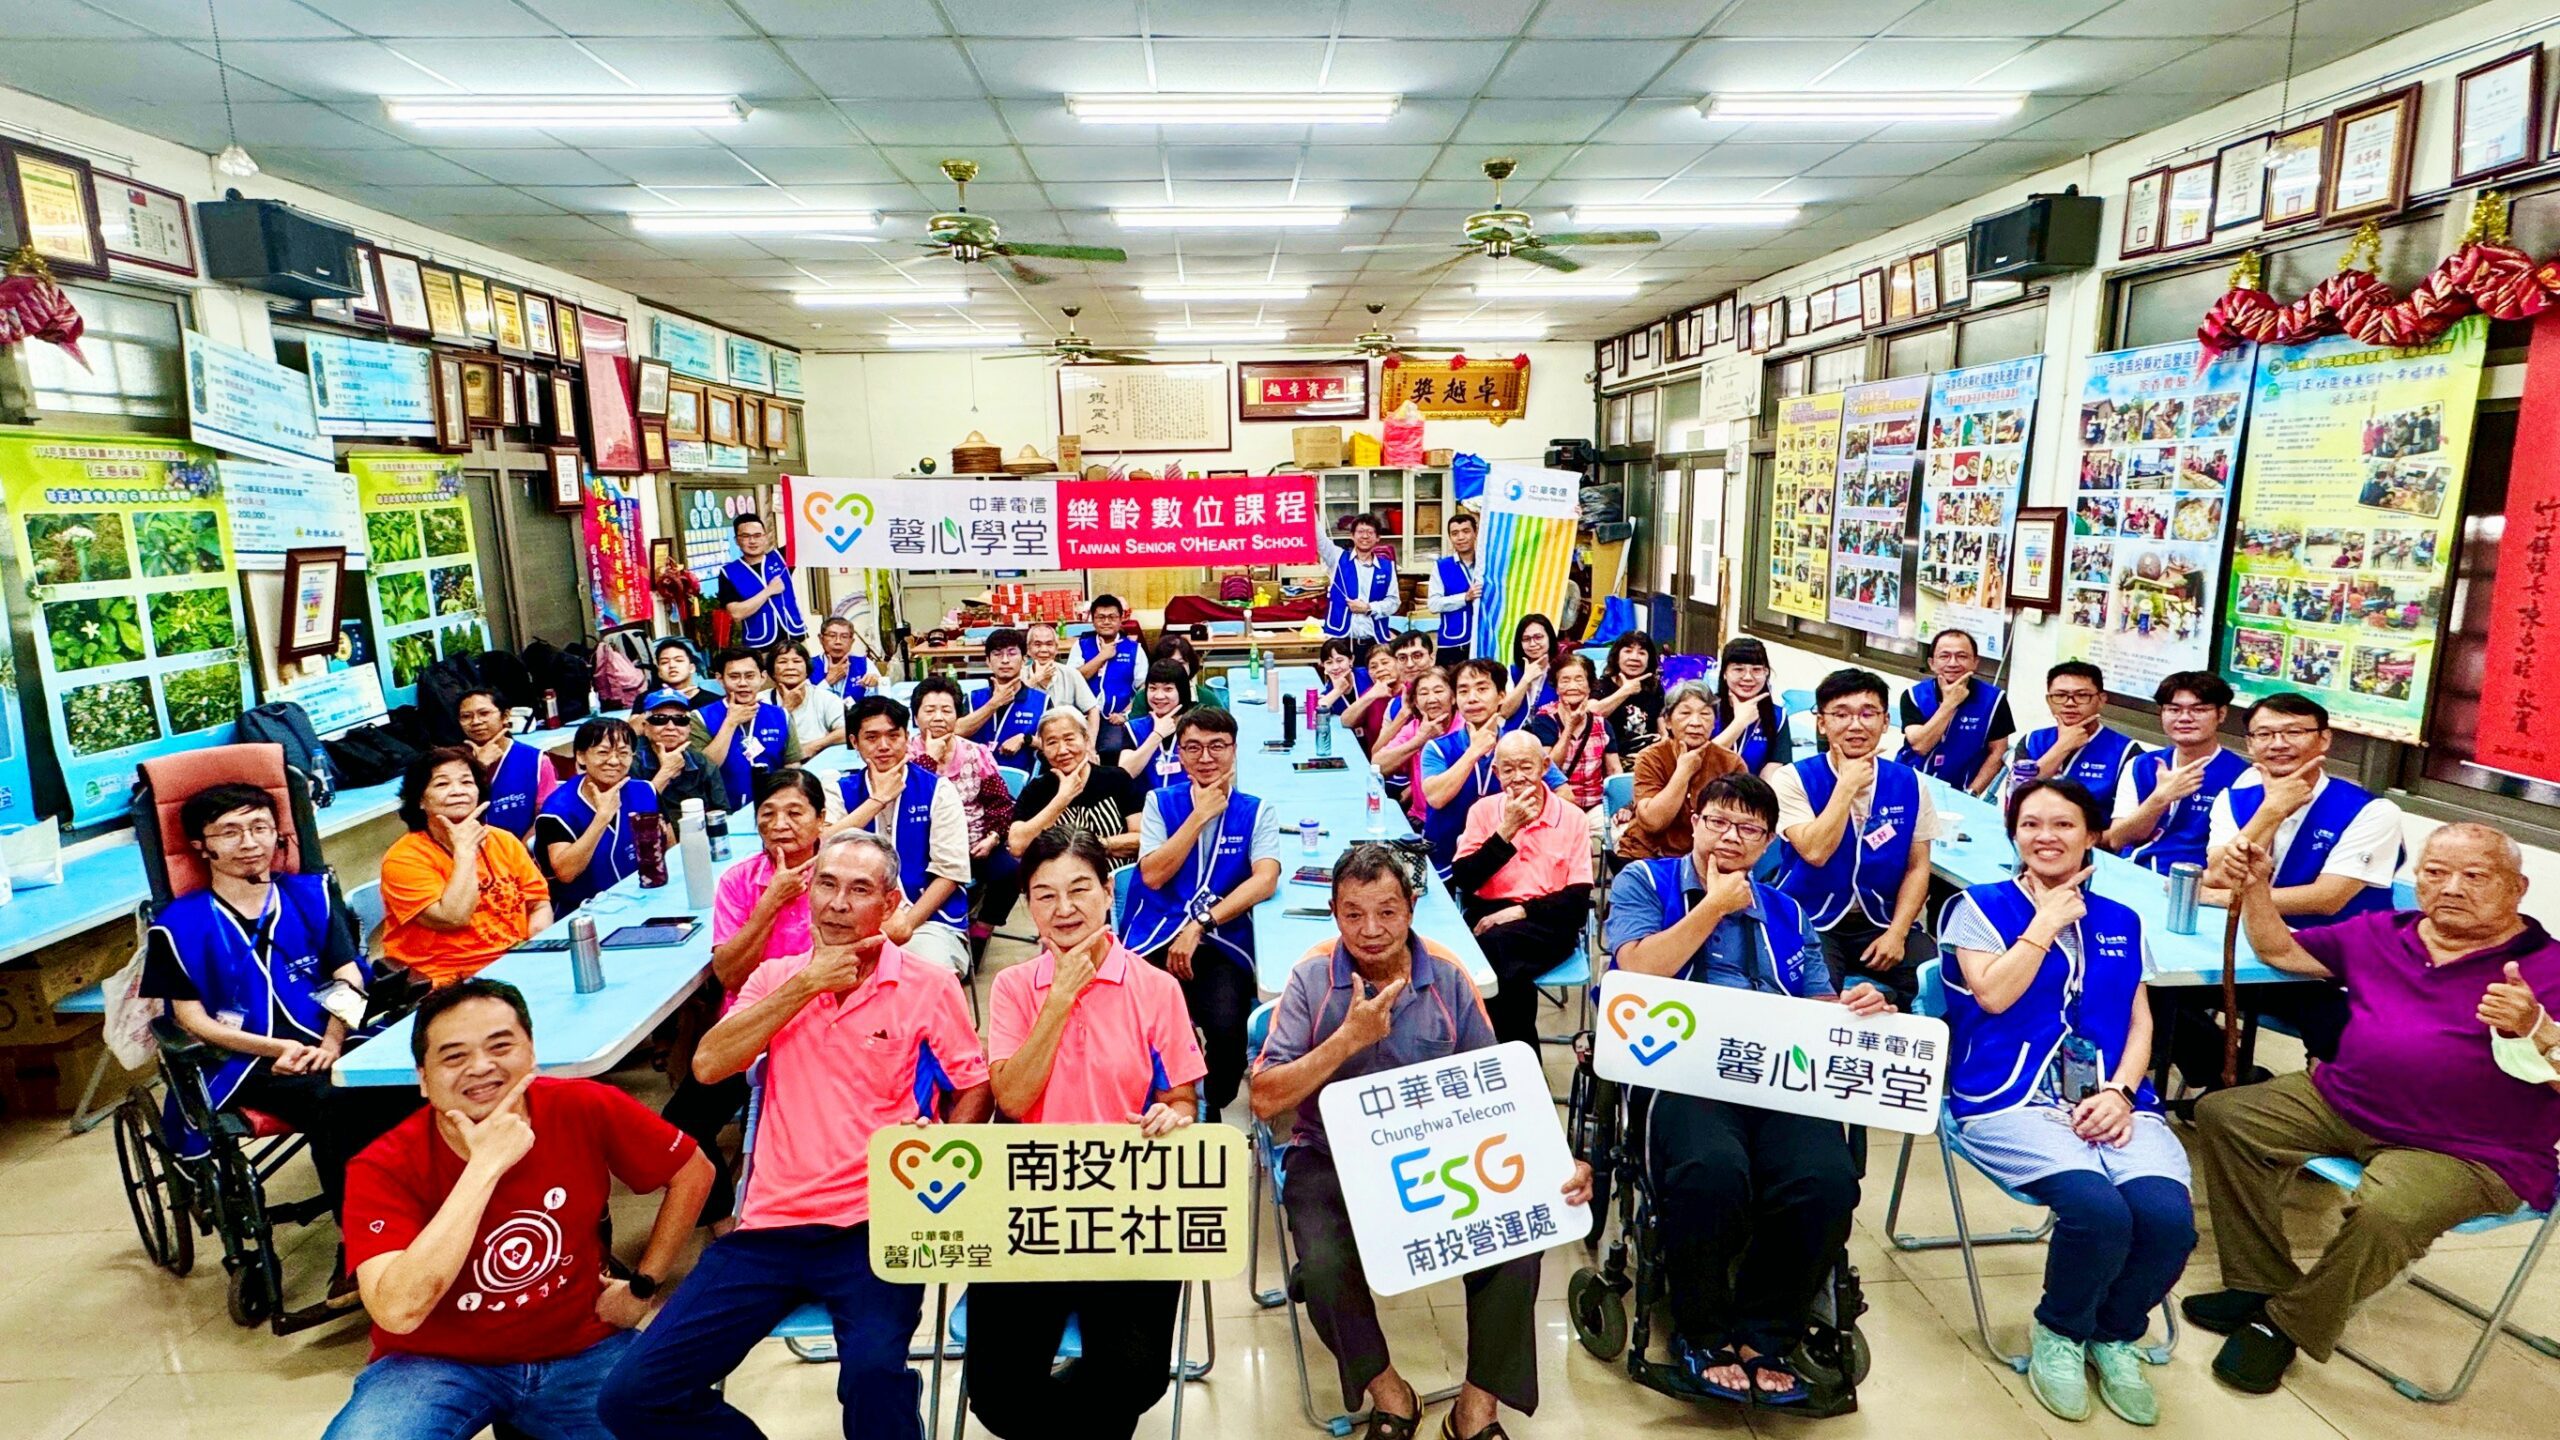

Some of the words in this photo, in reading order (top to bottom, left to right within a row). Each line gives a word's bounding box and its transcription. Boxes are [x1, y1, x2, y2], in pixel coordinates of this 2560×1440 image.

[969, 496, 1048, 514] 中華電信
[1066, 491, 1309, 531] 樂齡數位課程
[1529, 485, 1568, 497] 中華電信
[888, 516, 1049, 556] 馨心學堂
[1829, 1027, 1937, 1061] 中華電信
[1359, 1057, 1508, 1119] 中華電信
[1716, 1037, 1932, 1113] 馨心學堂
[1371, 1116, 1454, 1146] Chunghwa
[1453, 1100, 1516, 1127] Telecom
[1006, 1139, 1227, 1191] 南投竹山
[911, 1230, 965, 1242] 中華電信
[1007, 1205, 1228, 1256] 延正社區
[1402, 1202, 1559, 1277] 南投營運處
[884, 1244, 993, 1269] 馨心學堂
